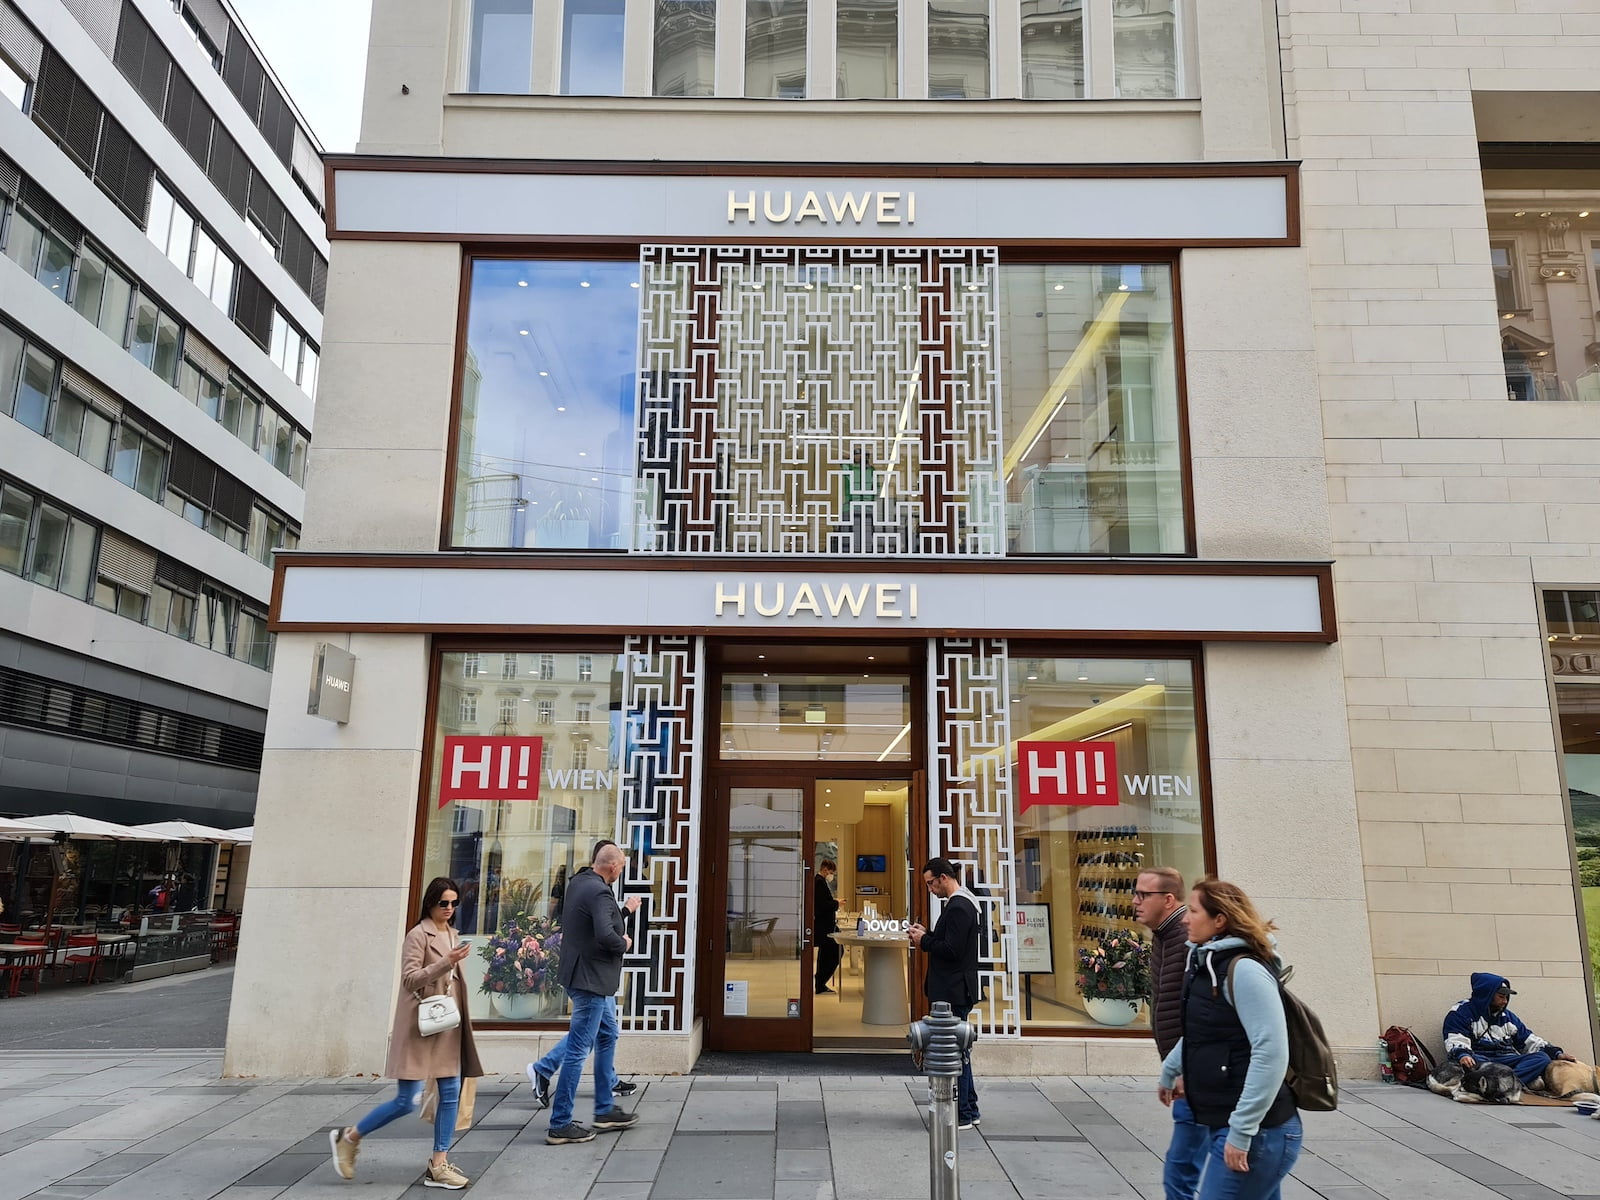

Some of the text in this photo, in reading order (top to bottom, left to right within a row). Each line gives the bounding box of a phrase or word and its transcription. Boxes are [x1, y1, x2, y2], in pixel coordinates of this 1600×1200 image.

[727, 190, 916, 225] HUAWEI
[715, 582, 919, 619] HUAWEI
[325, 675, 350, 692] HUAWEI
[450, 745, 613, 790] HI! WIEN
[1028, 750, 1193, 796] HI! WIEN
[862, 918, 899, 932] nova
